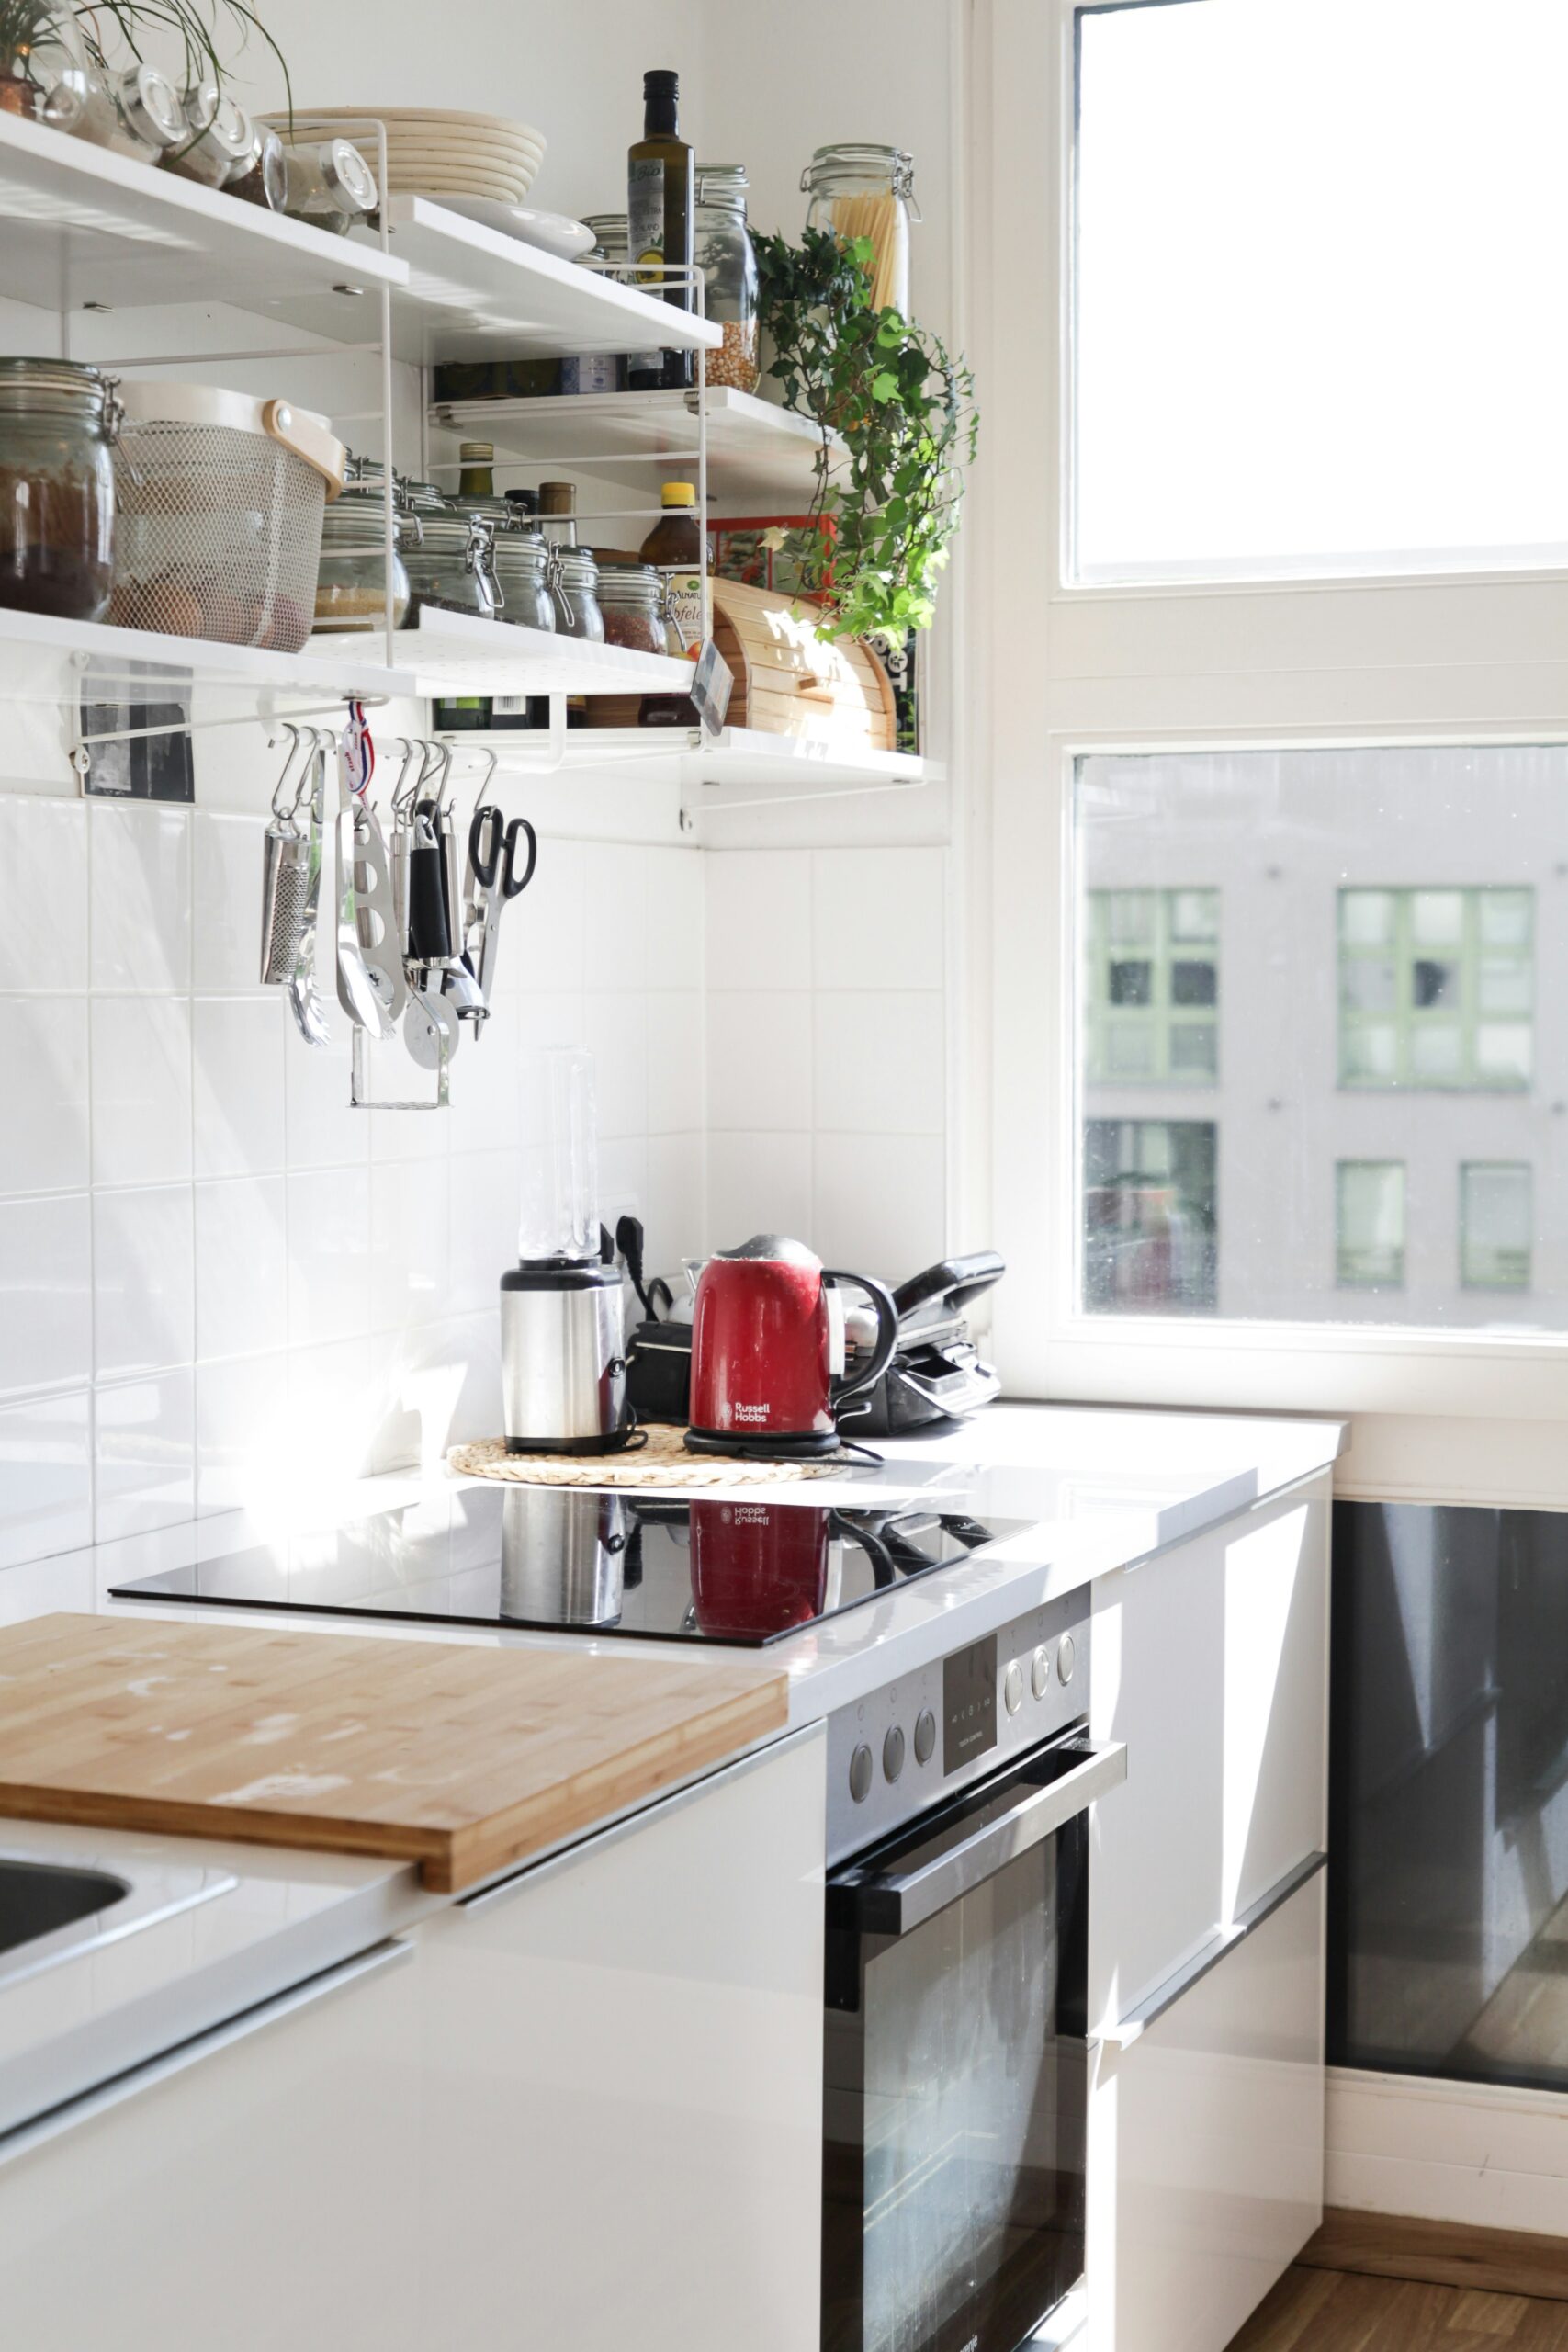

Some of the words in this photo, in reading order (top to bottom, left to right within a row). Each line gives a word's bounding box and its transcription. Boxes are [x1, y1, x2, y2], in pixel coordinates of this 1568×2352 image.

[637, 165, 660, 181] Bio
[735, 1402, 771, 1413] Russell
[735, 1412, 767, 1423] Hobbs
